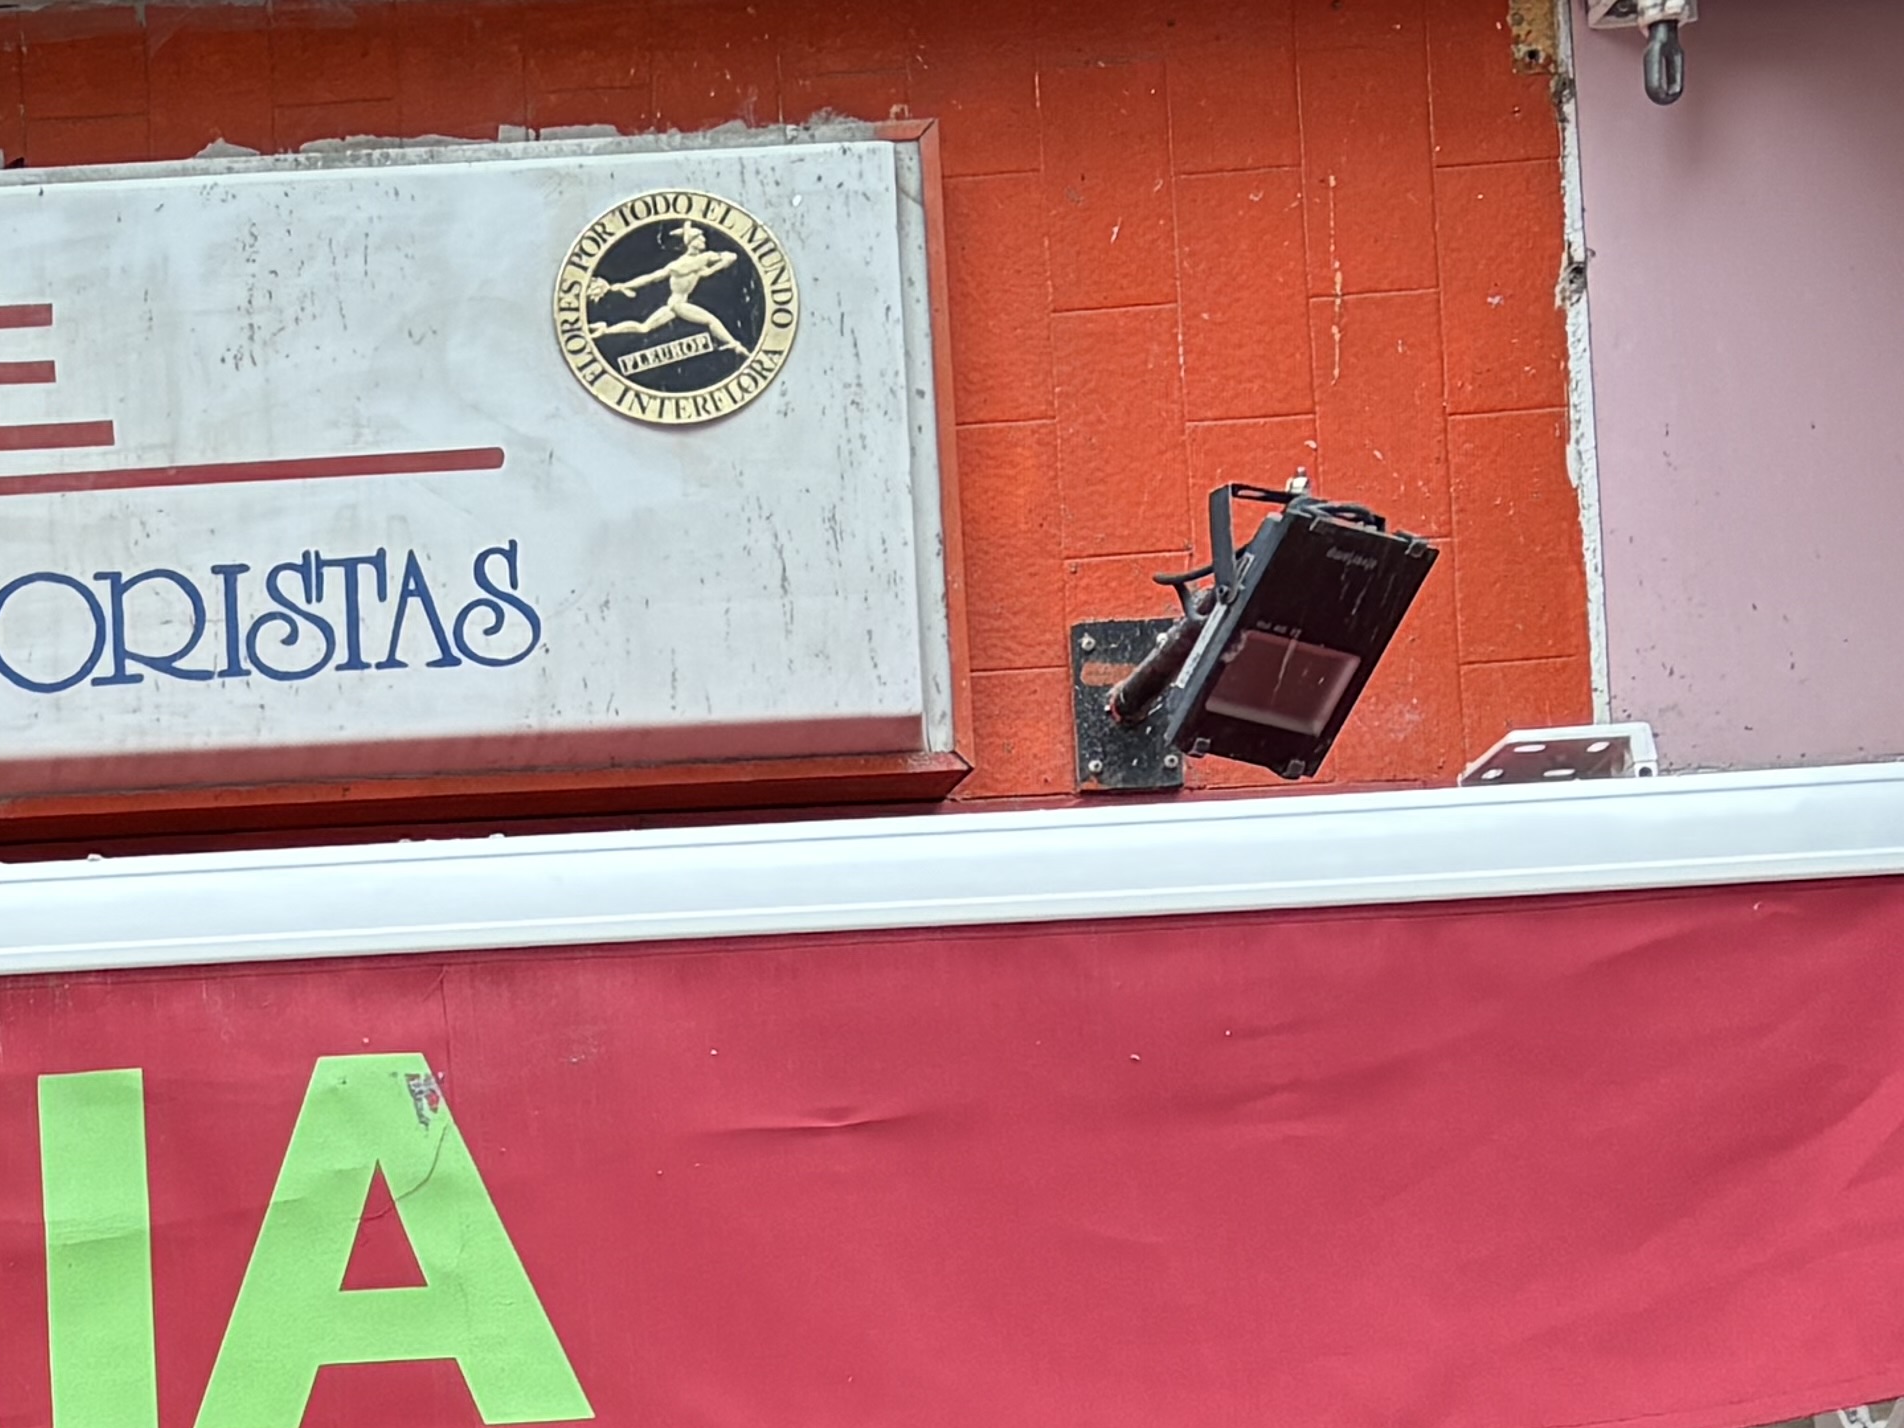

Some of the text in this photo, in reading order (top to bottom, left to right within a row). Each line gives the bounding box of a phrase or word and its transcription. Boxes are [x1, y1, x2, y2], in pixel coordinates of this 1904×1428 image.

[571, 220, 614, 272] POR
[614, 193, 693, 226] TODO
[702, 198, 734, 230] EL
[740, 223, 793, 329] MUNDO
[616, 349, 784, 420] INTERFLORA
[621, 335, 710, 374] FLEUROP
